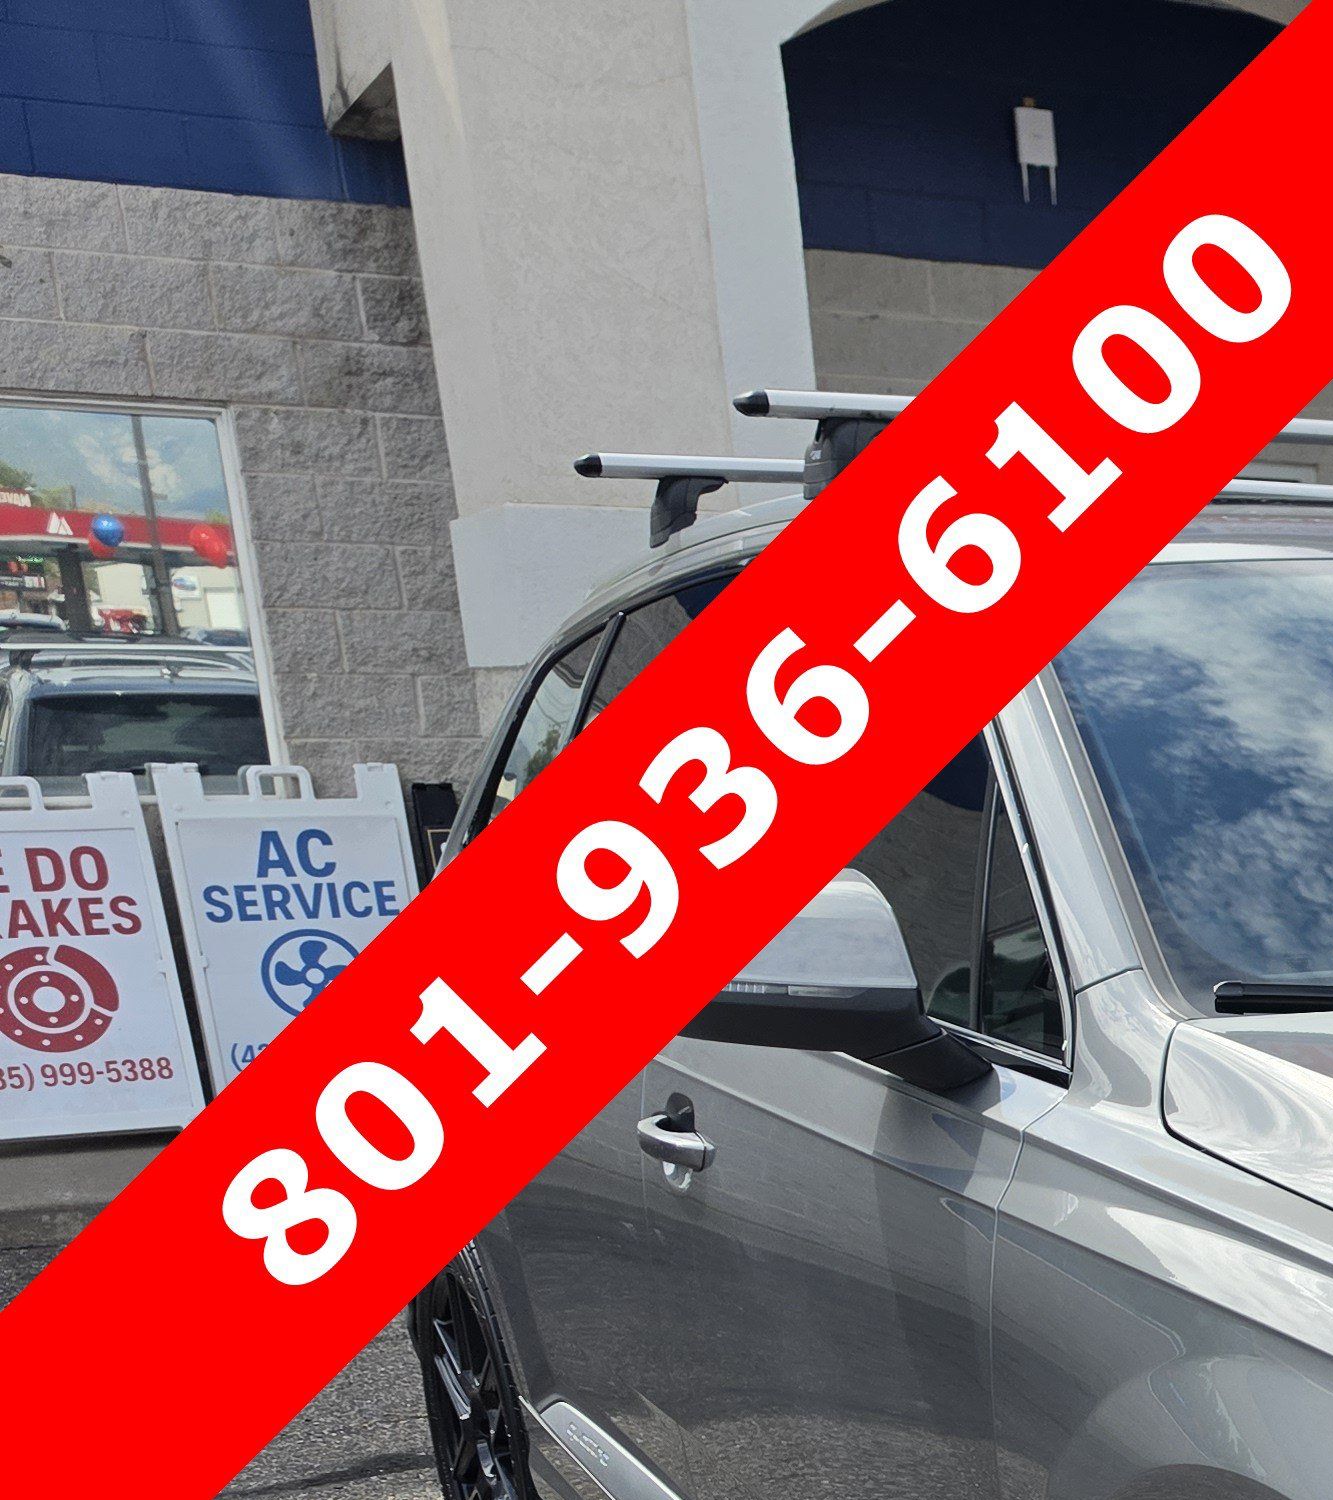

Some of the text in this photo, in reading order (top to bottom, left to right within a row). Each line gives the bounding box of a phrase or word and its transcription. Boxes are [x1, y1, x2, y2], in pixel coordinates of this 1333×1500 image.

[24, 845, 109, 892] DO
[255, 828, 337, 878] AC
[0, 895, 142, 938] AKES
[203, 879, 400, 923] SERVICE
[41, 1056, 174, 1087] 999-5388
[231, 1043, 268, 1071] (4
